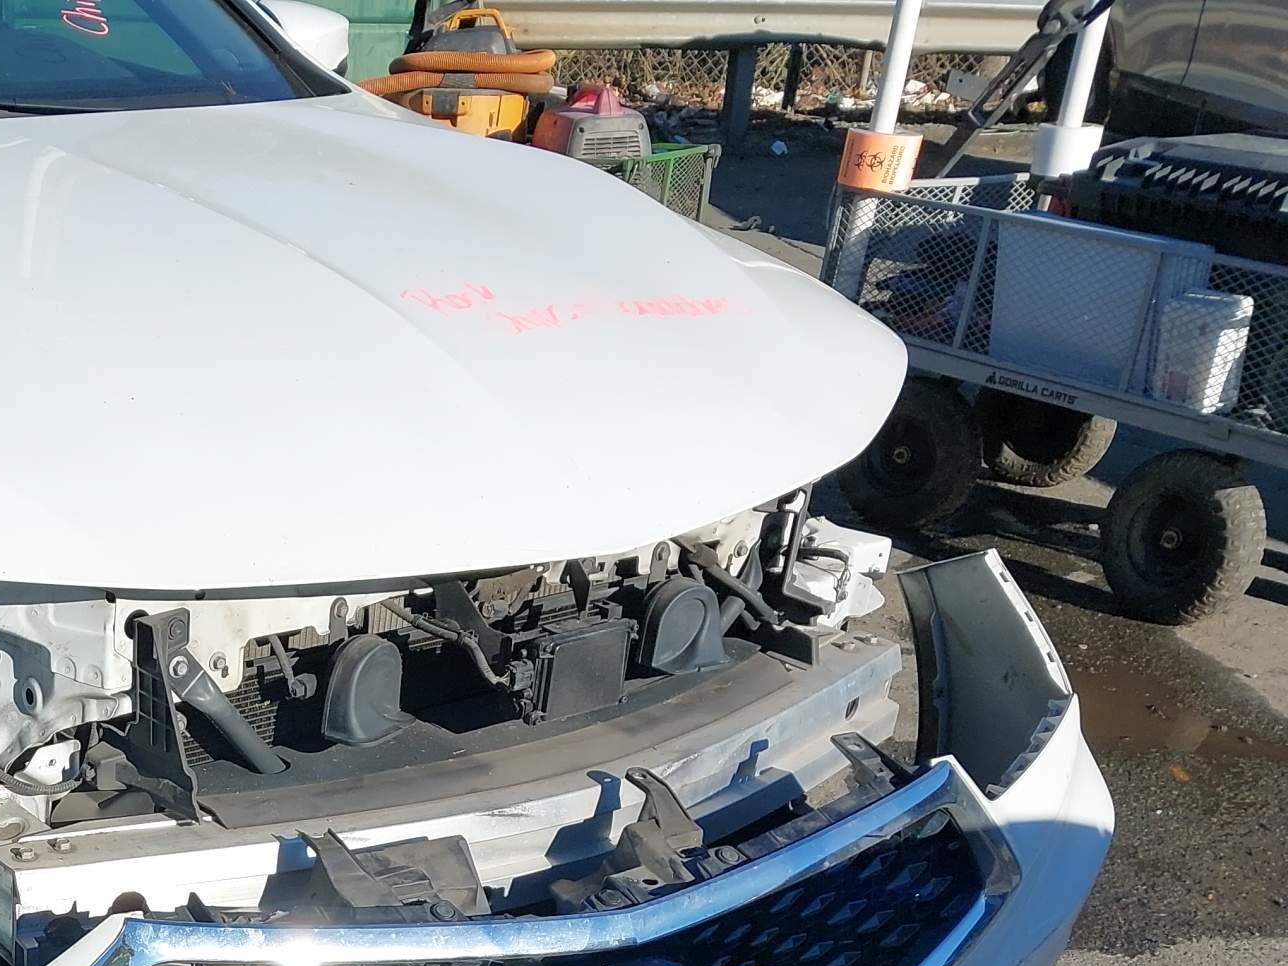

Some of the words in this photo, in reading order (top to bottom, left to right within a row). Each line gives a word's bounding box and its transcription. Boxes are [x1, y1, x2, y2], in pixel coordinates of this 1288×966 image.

[881, 144, 899, 184] BIOHAZARD
[998, 375, 1040, 394] GORILLA
[1040, 387, 1077, 405] CARTS
